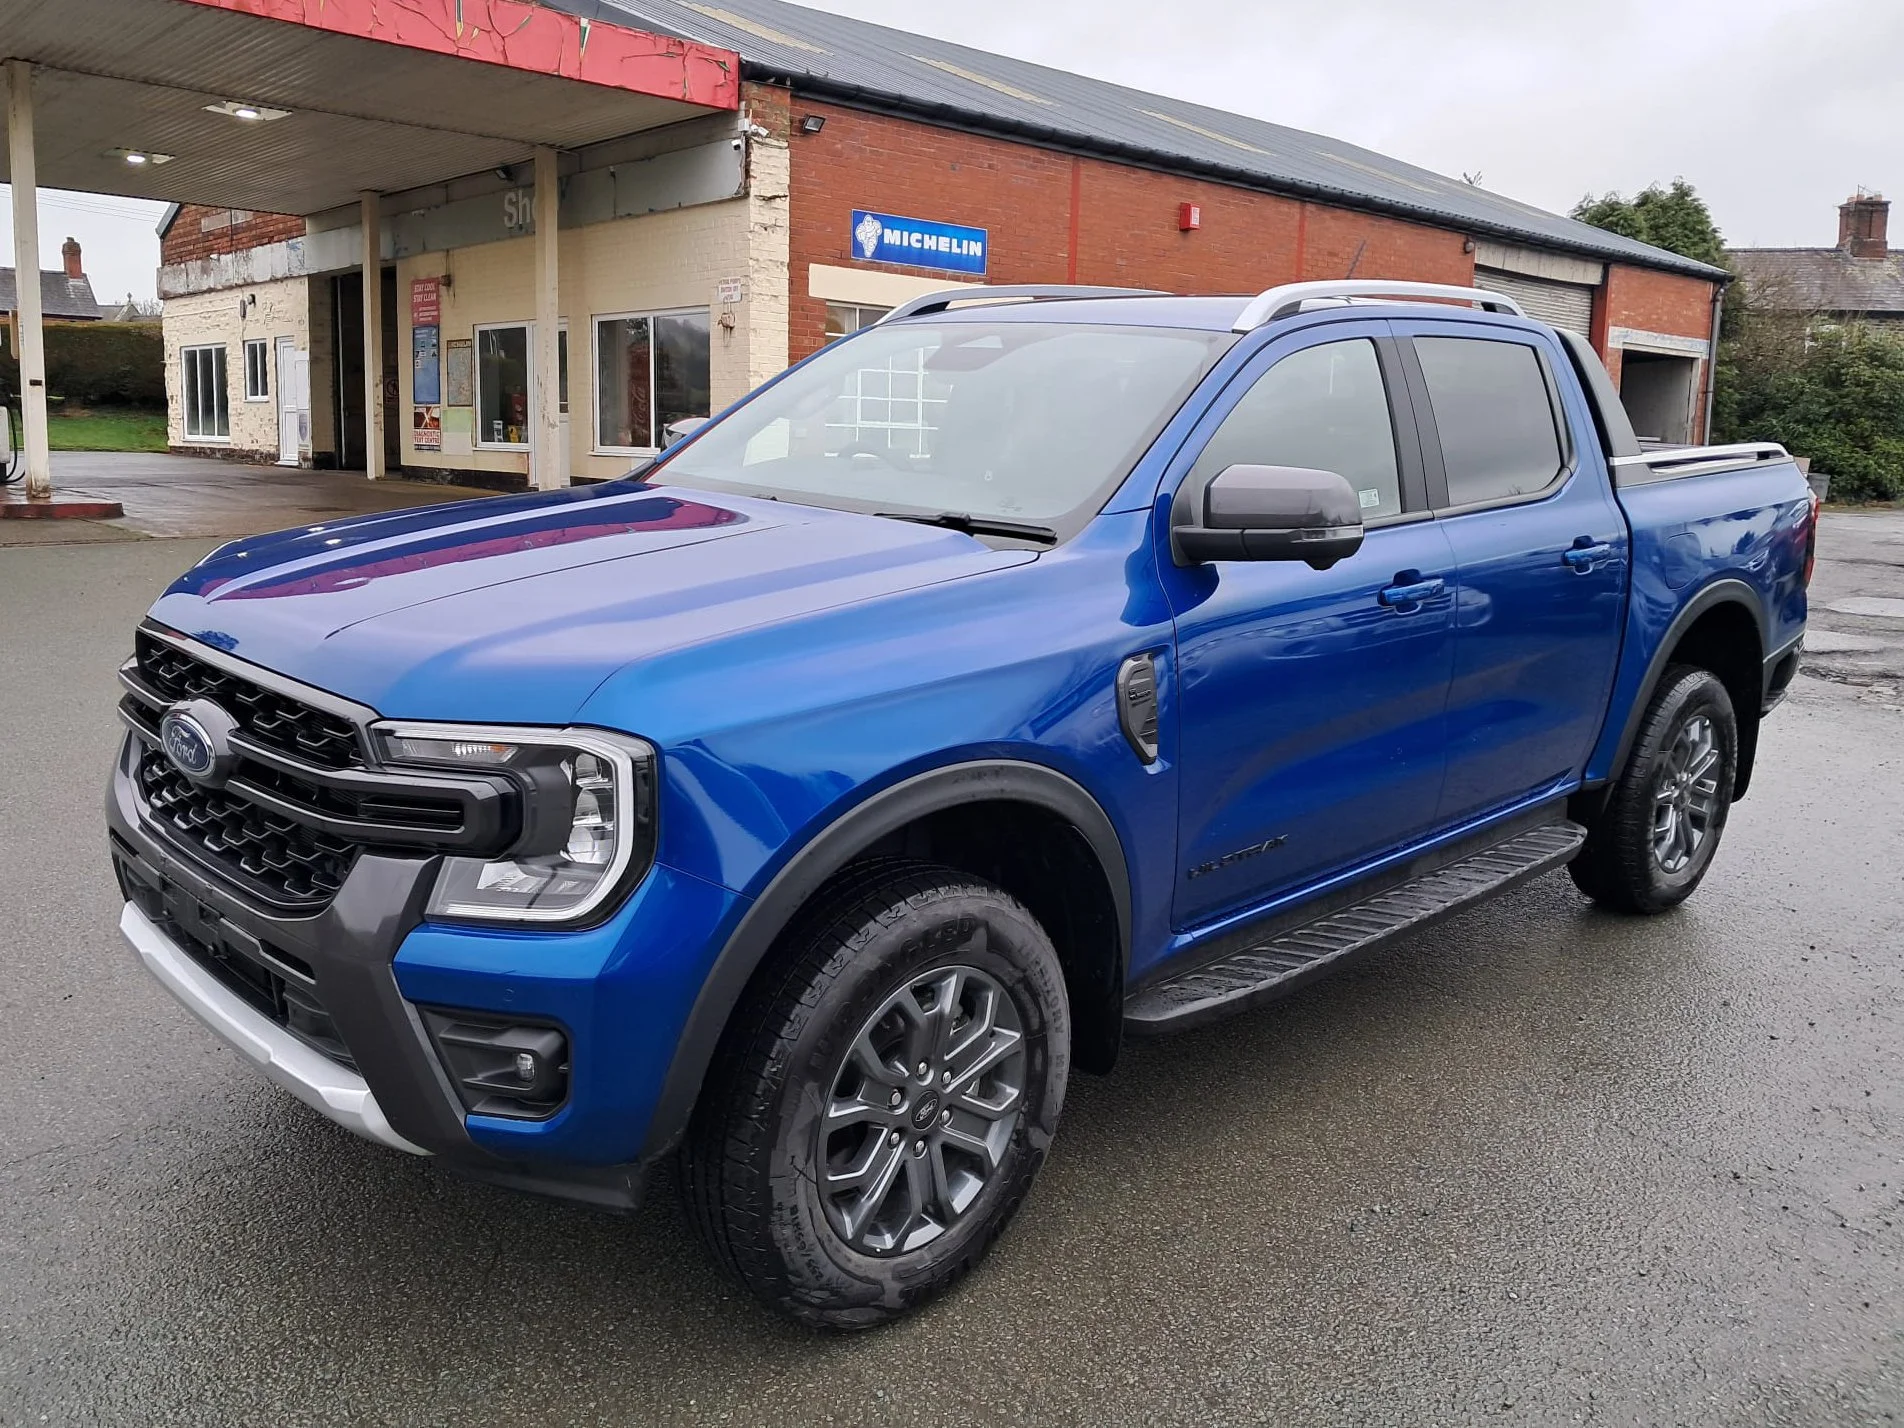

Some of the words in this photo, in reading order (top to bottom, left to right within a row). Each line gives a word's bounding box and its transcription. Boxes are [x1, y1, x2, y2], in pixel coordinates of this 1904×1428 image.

[883, 228, 983, 257] MICHELIN
[414, 284, 424, 292] STAY
[424, 282, 436, 291] COOL
[413, 294, 423, 303] STAY
[423, 293, 437, 302] CLEAN
[169, 725, 198, 765] Ford
